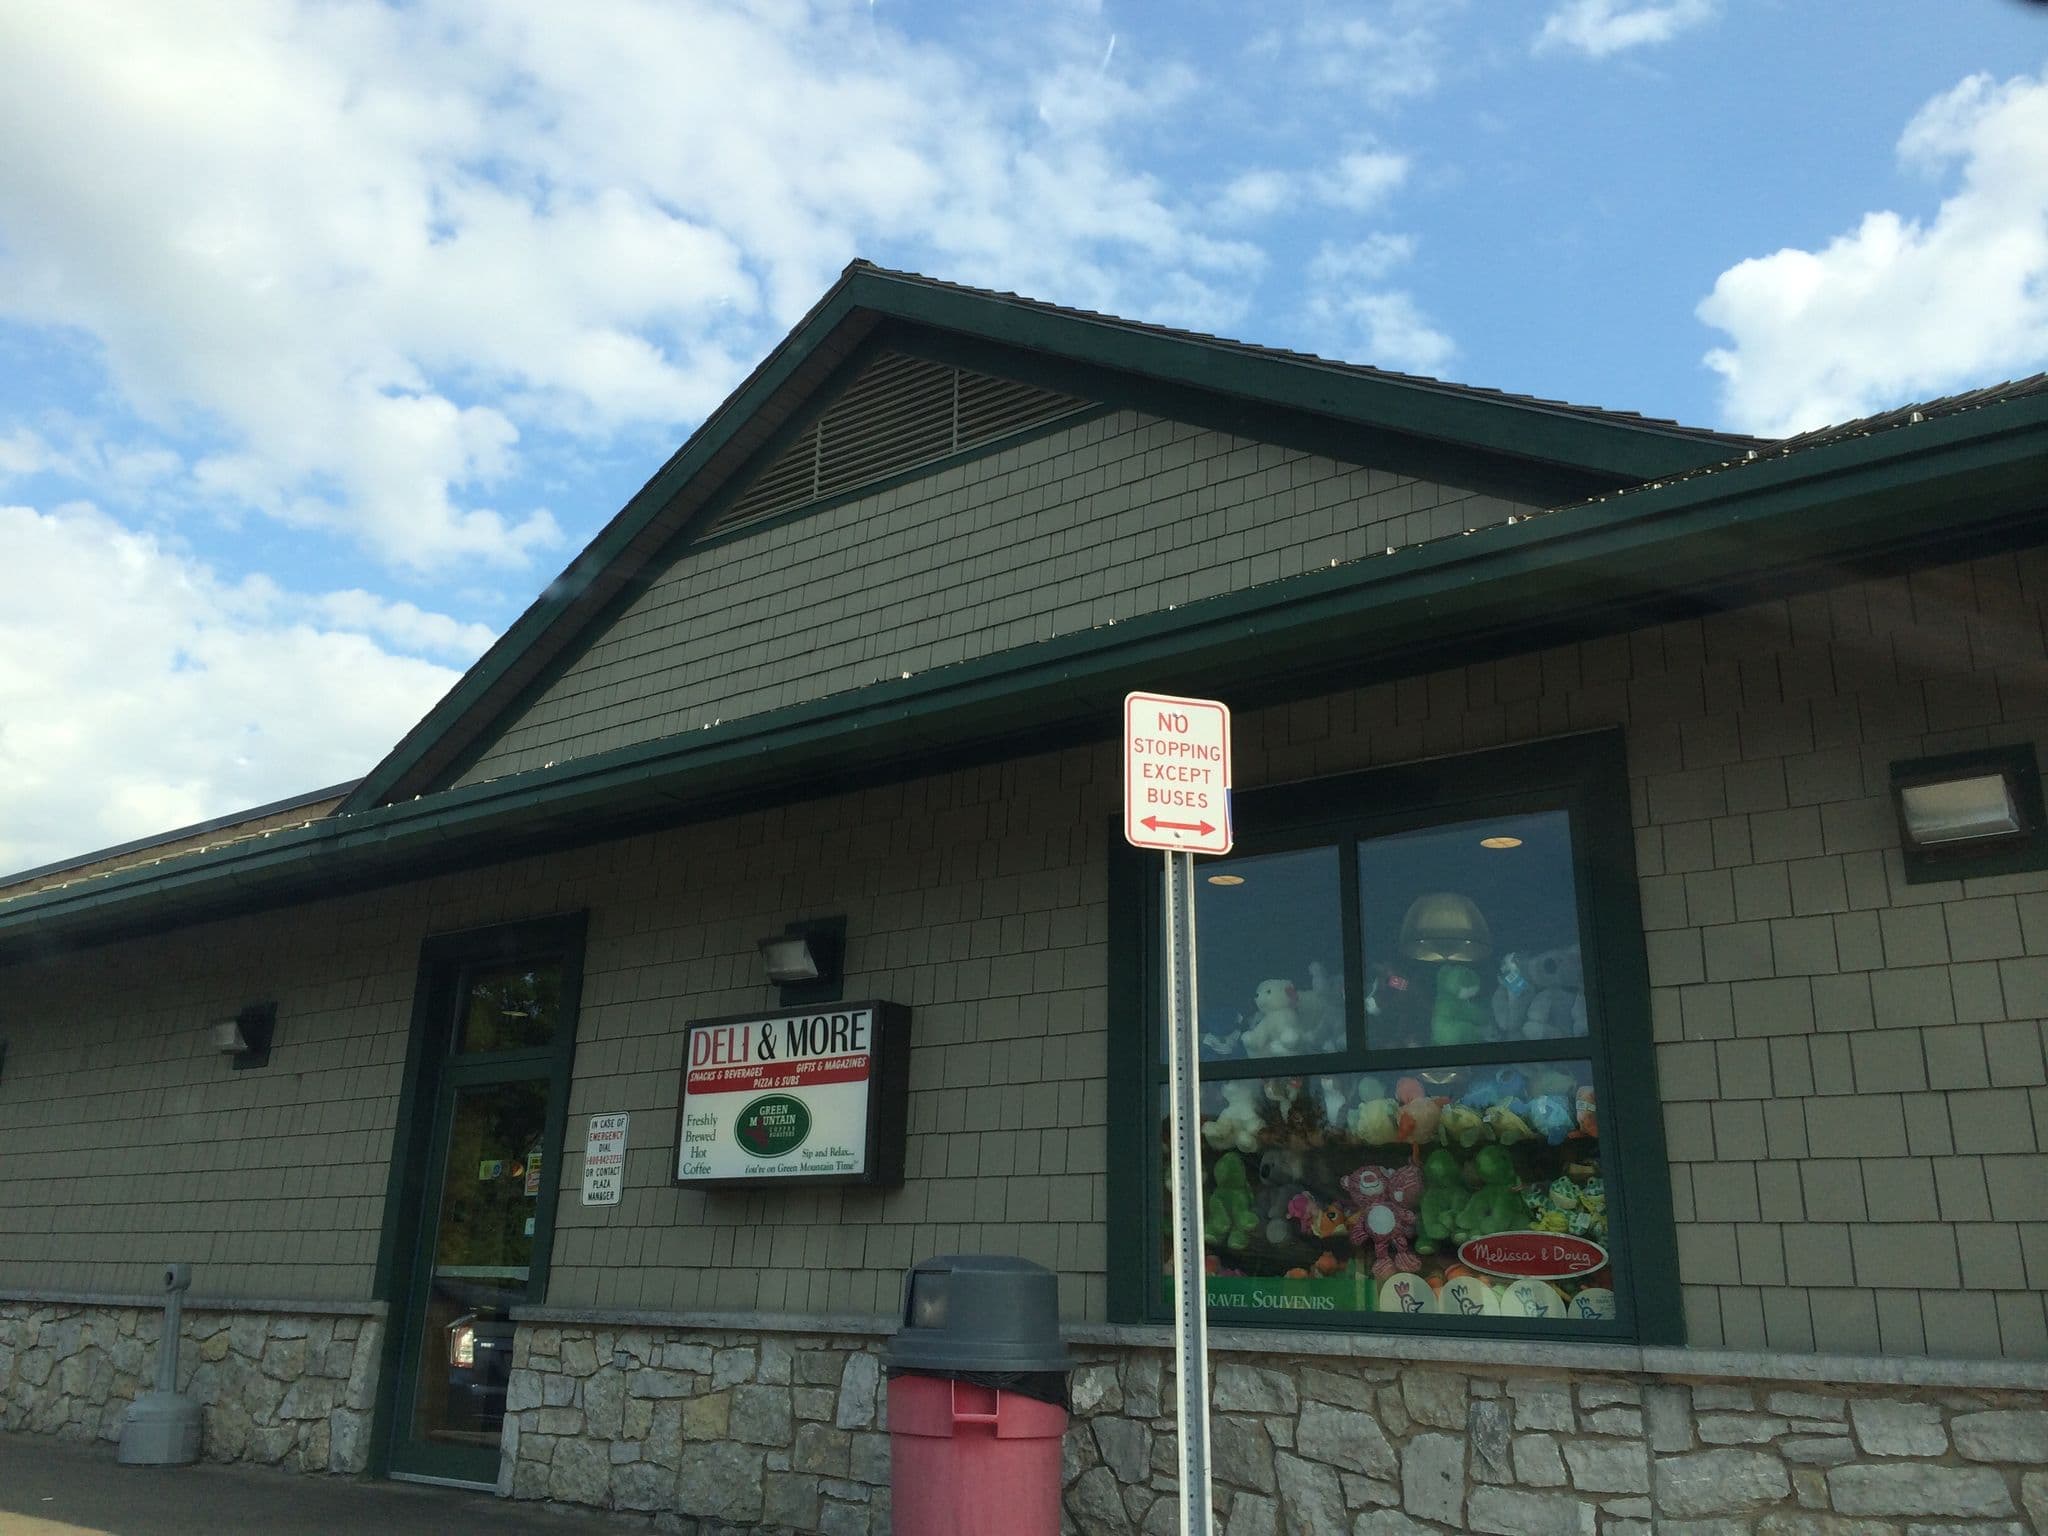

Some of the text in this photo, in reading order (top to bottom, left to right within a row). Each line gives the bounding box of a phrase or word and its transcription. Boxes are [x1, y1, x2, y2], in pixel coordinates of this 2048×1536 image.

[1158, 712, 1189, 734] NO
[1134, 738, 1220, 761] STOPPING
[1143, 763, 1211, 784] EXCEPT
[1148, 788, 1208, 808] BUSES
[692, 1012, 867, 1067] DELI & MORE
[796, 1057, 866, 1073] GIFTS & MAGAZINES
[690, 1067, 764, 1082] SNACKS & BEVERAGES
[753, 1076, 800, 1088] PIZZA & SUBS
[759, 1105, 789, 1116] GREEN
[591, 1117, 625, 1129] IN CASE OF
[687, 1113, 718, 1128] Freshly
[590, 1131, 624, 1142] EMERGENCY
[685, 1127, 716, 1142] Brewed
[599, 1142, 611, 1152] DIAL
[690, 1146, 707, 1159] Hot
[802, 1149, 813, 1158] Sip
[815, 1148, 828, 1157] and
[586, 1166, 621, 1177] OR CONTACT
[683, 1162, 711, 1175] Coffee
[767, 1165, 776, 1173] on
[777, 1162, 798, 1173] Green
[799, 1161, 834, 1172] Mountain
[592, 1179, 611, 1188] PLAZA
[588, 1191, 615, 1201] MANAGER
[1473, 1242, 1537, 1265] Melissa
[1553, 1246, 1591, 1270] Doug
[1207, 1294, 1247, 1308] RAVEL
